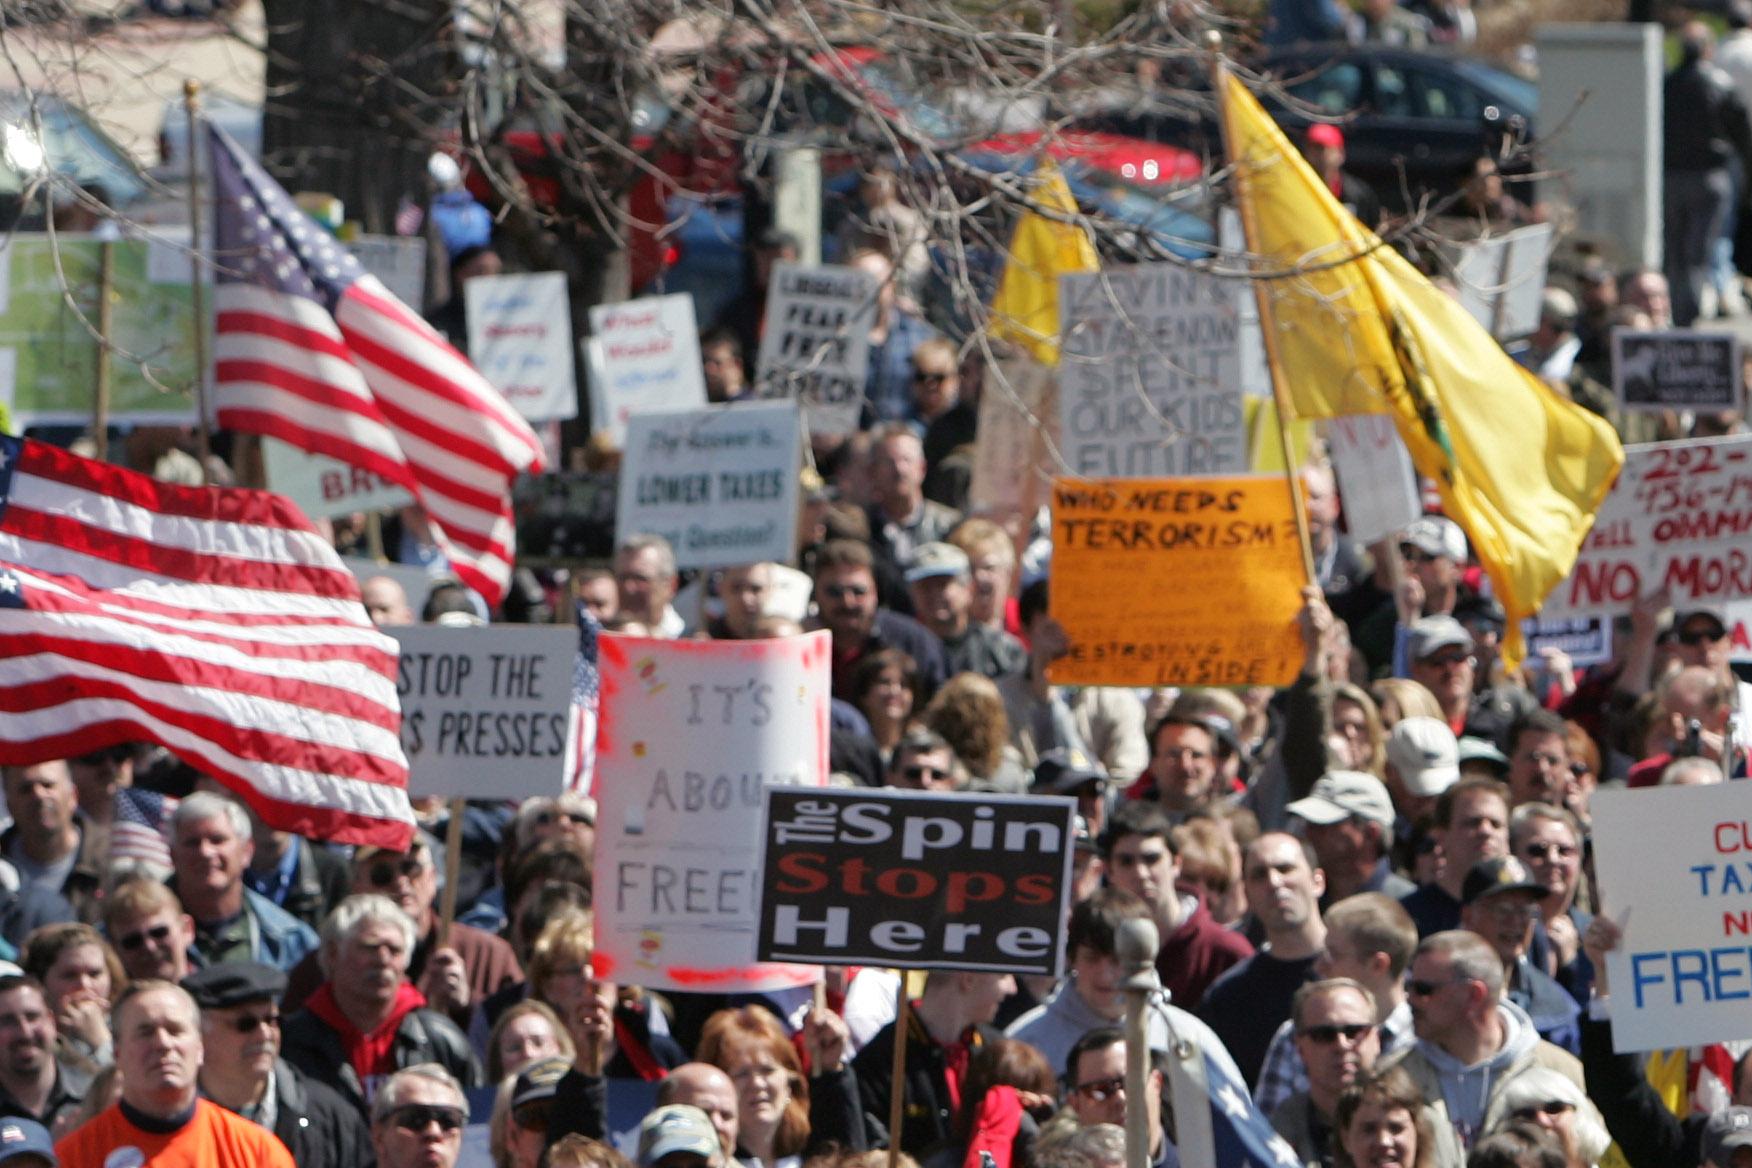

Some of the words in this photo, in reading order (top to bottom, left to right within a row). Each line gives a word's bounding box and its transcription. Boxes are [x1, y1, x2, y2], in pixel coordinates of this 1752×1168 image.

[636, 473, 713, 507] LOWER
[719, 469, 786, 500] TAXES
[1126, 489, 1245, 513] NEEDS
[1570, 559, 1641, 609] NO
[1729, 619, 1752, 651] A
[399, 653, 472, 698] STOP
[489, 654, 545, 699] THE
[685, 679, 775, 728] IT'S
[436, 713, 567, 757] PRESSES
[772, 799, 838, 846] The
[838, 802, 1062, 861] Spin
[774, 851, 1057, 914] Stops
[772, 903, 1053, 958] Here
